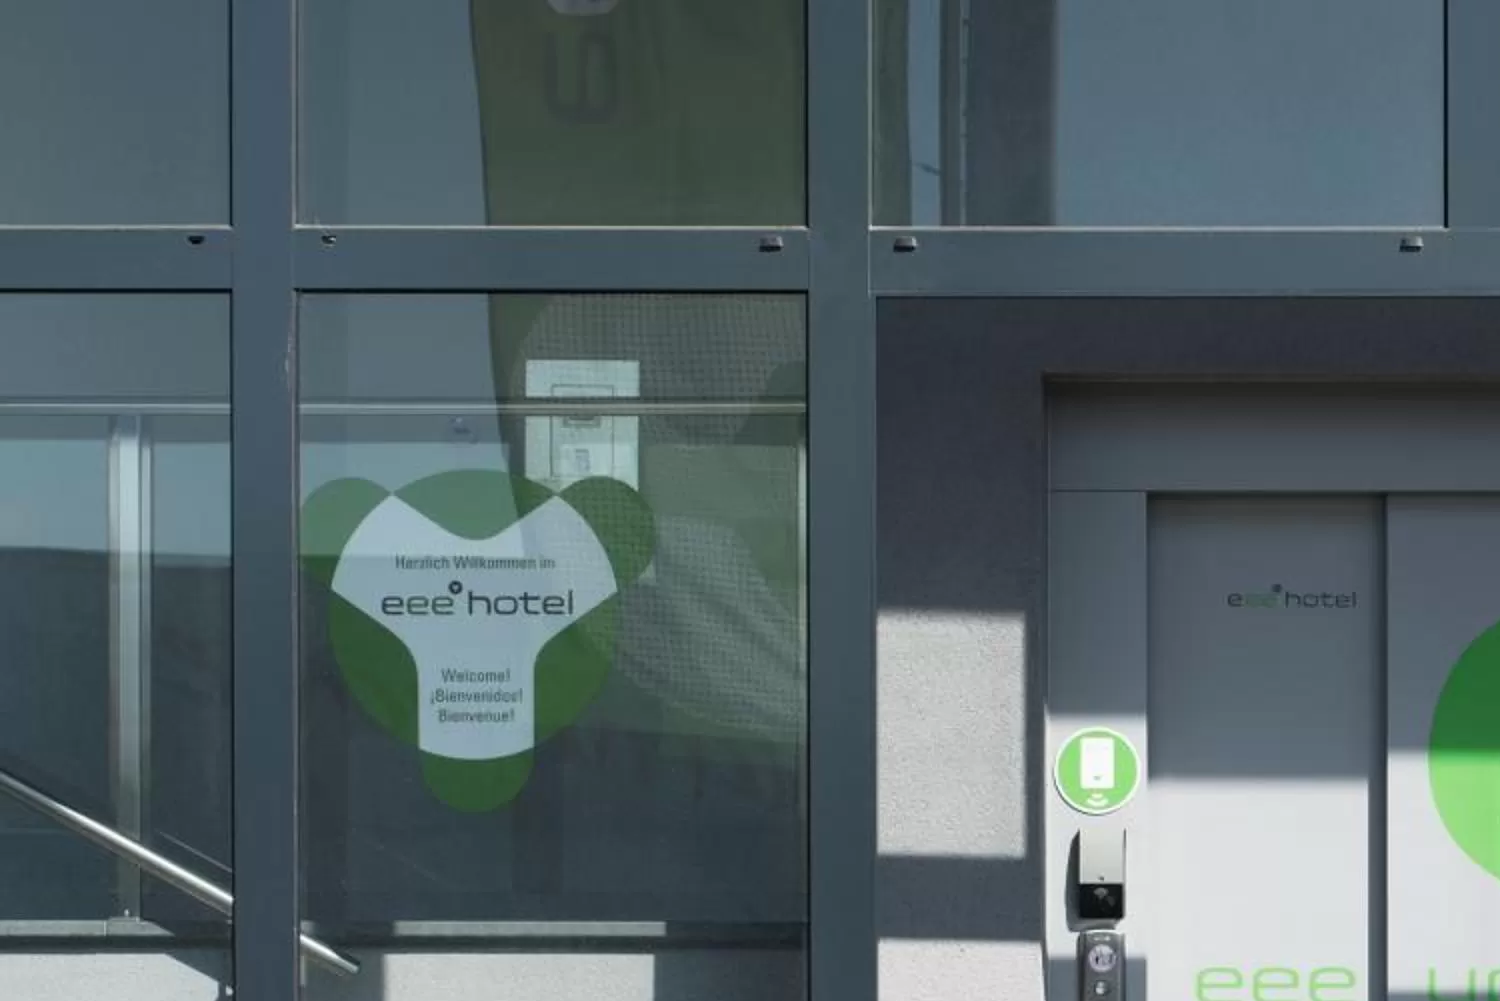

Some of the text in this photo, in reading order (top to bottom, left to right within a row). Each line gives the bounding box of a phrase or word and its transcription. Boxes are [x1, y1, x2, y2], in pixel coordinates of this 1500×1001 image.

[395, 555, 449, 569] Herzlich
[453, 556, 536, 569] Willkommen
[468, 589, 574, 615] hotel
[1285, 591, 1356, 608] hotel
[441, 668, 511, 683] Welcome!
[439, 708, 515, 723] Bienvenue!
